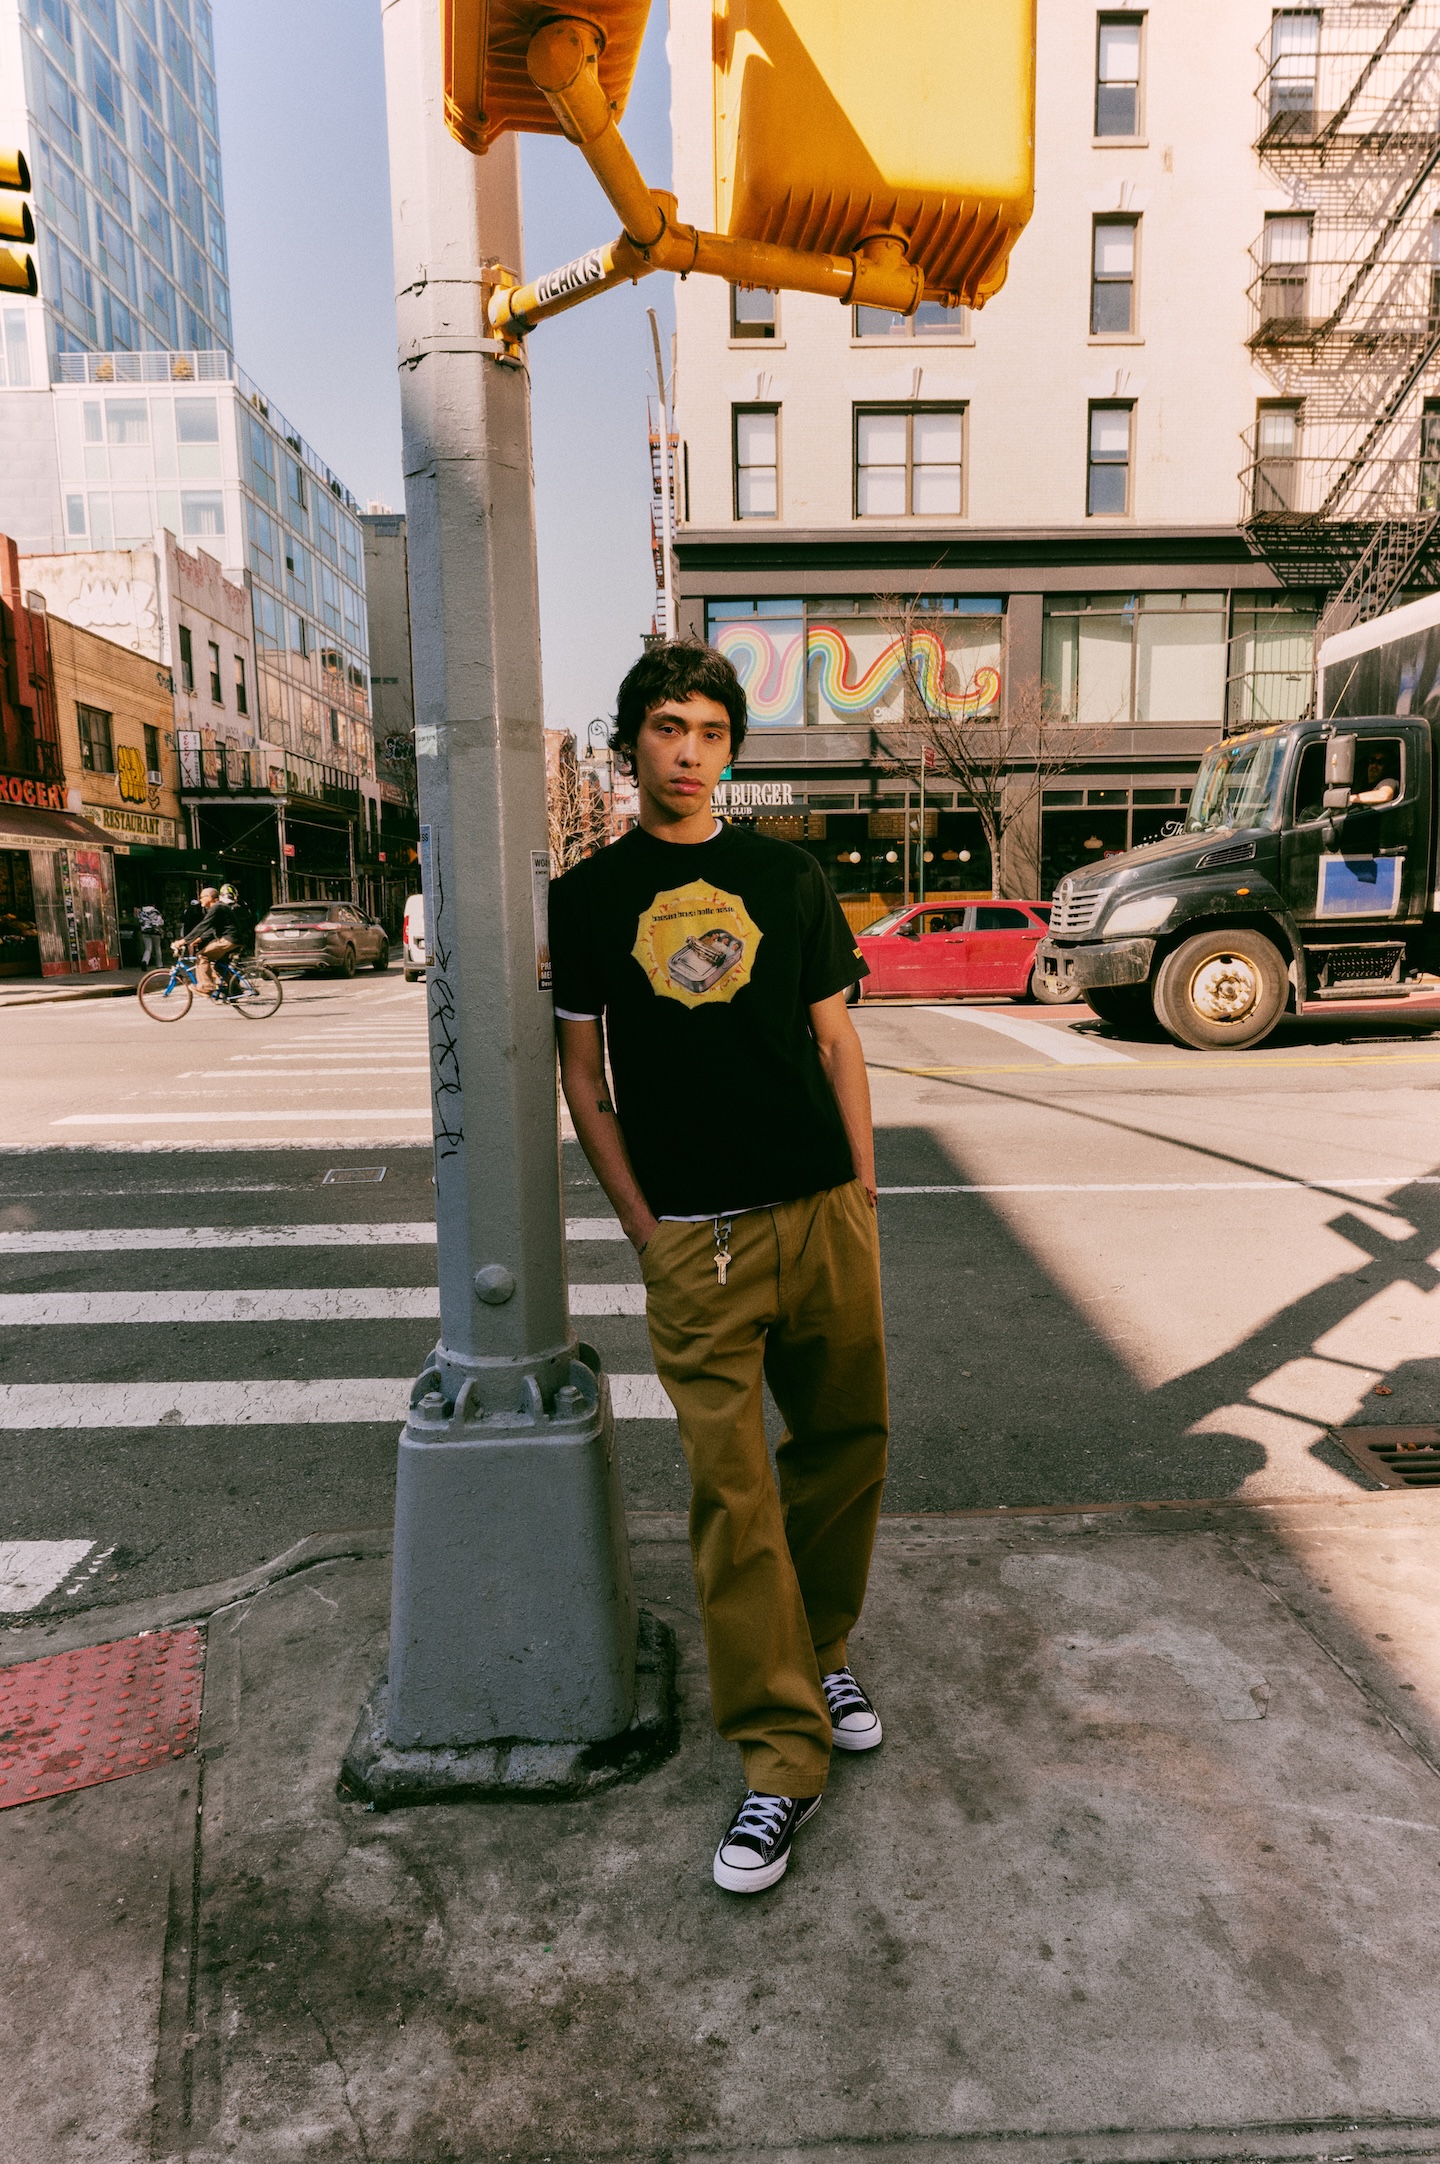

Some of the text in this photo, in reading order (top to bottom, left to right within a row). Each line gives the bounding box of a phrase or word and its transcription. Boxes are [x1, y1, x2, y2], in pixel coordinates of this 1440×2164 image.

[539, 249, 601, 301] HEARTS
[0, 775, 69, 809] ROCERY
[731, 784, 794, 805] BURGER
[103, 809, 159, 835] RESTAURANT
[730, 807, 753, 815] CLUB
